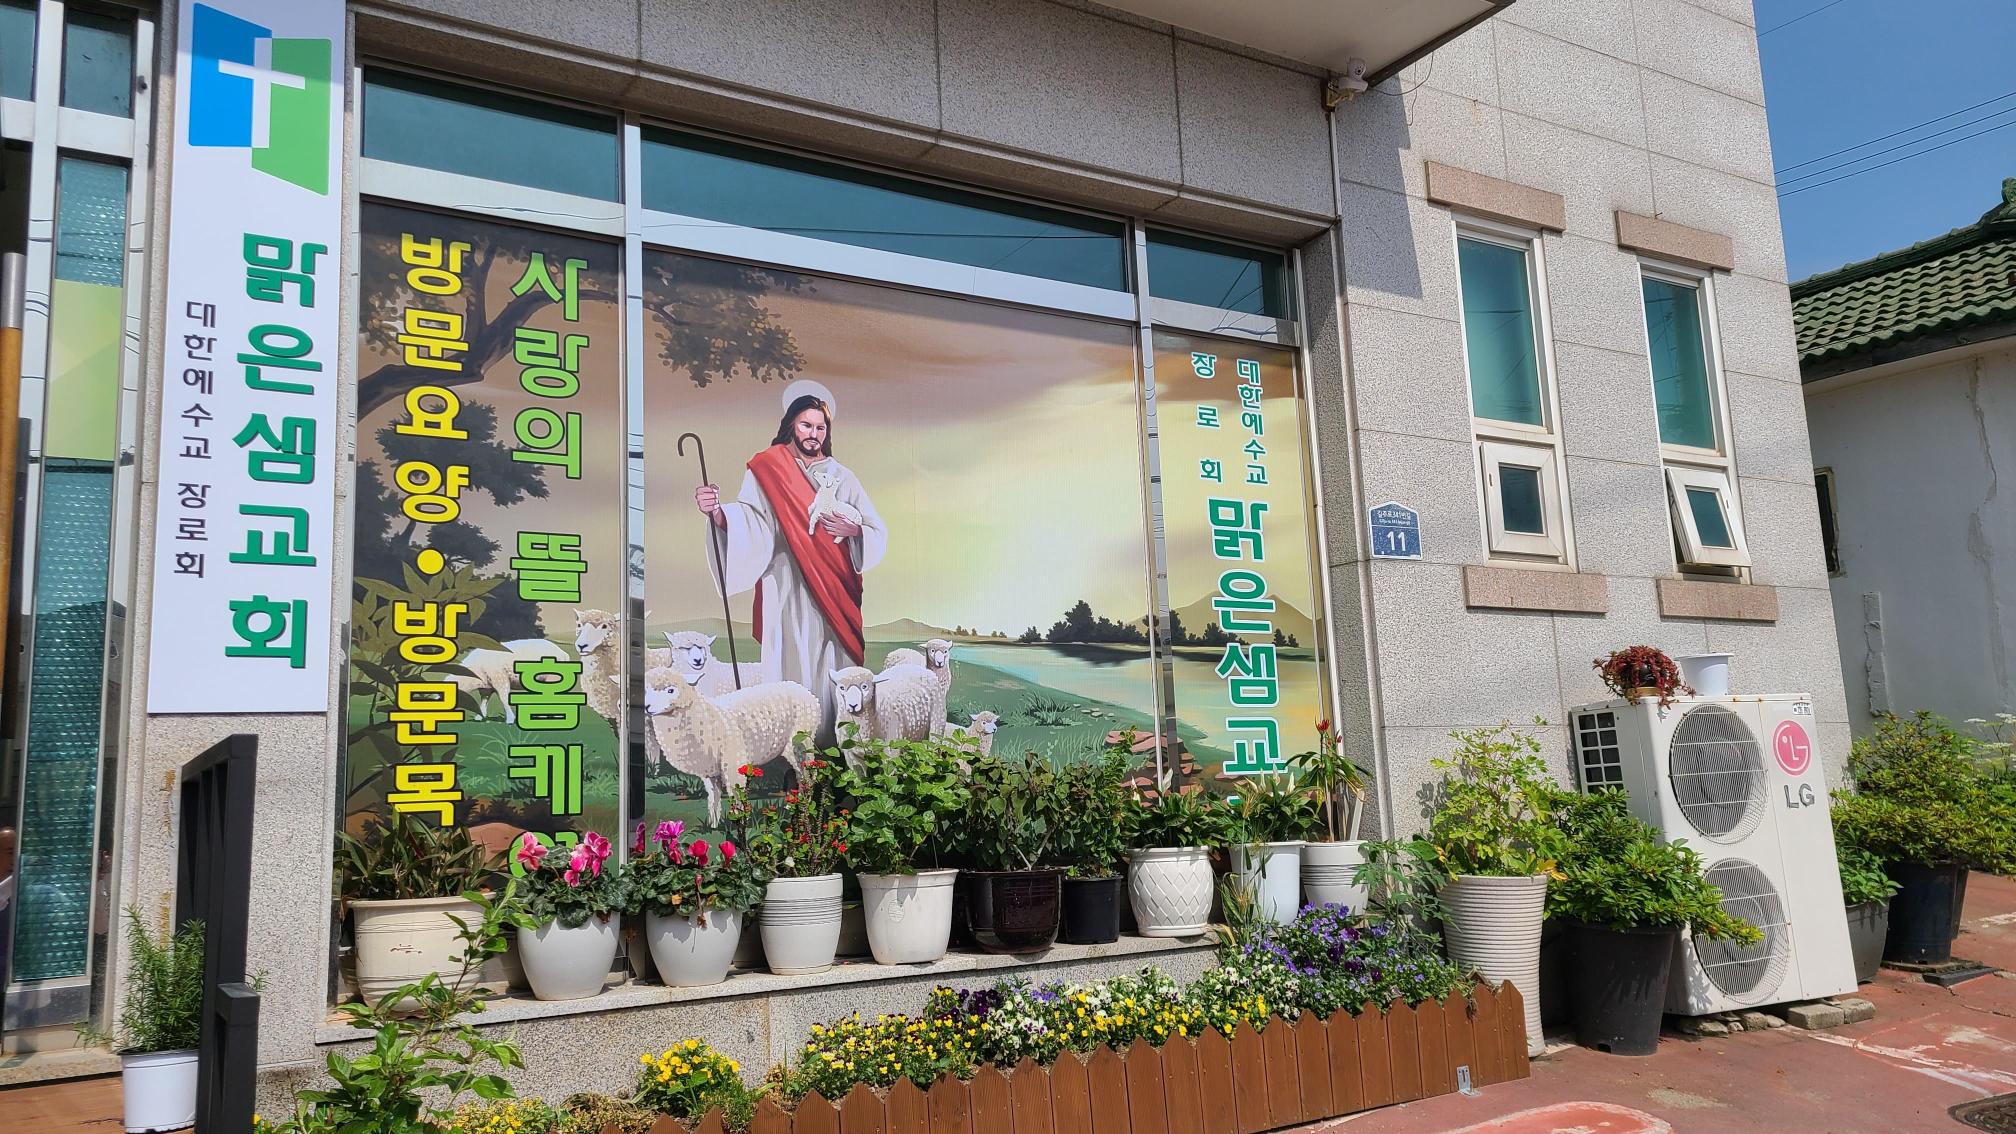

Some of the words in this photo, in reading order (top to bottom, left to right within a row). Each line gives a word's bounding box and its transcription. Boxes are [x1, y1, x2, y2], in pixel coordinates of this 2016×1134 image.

[179, 301, 218, 460] 대한예수교
[510, 251, 590, 480] 사랑의
[1236, 358, 1269, 486] 대한예수교
[225, 232, 328, 669] 맑은샘교회
[173, 482, 212, 579] 장로회
[509, 531, 588, 603] 뜰
[1387, 531, 1406, 552] 11
[1207, 497, 1288, 806] 맑은샘교
[1783, 783, 1815, 809] LG
